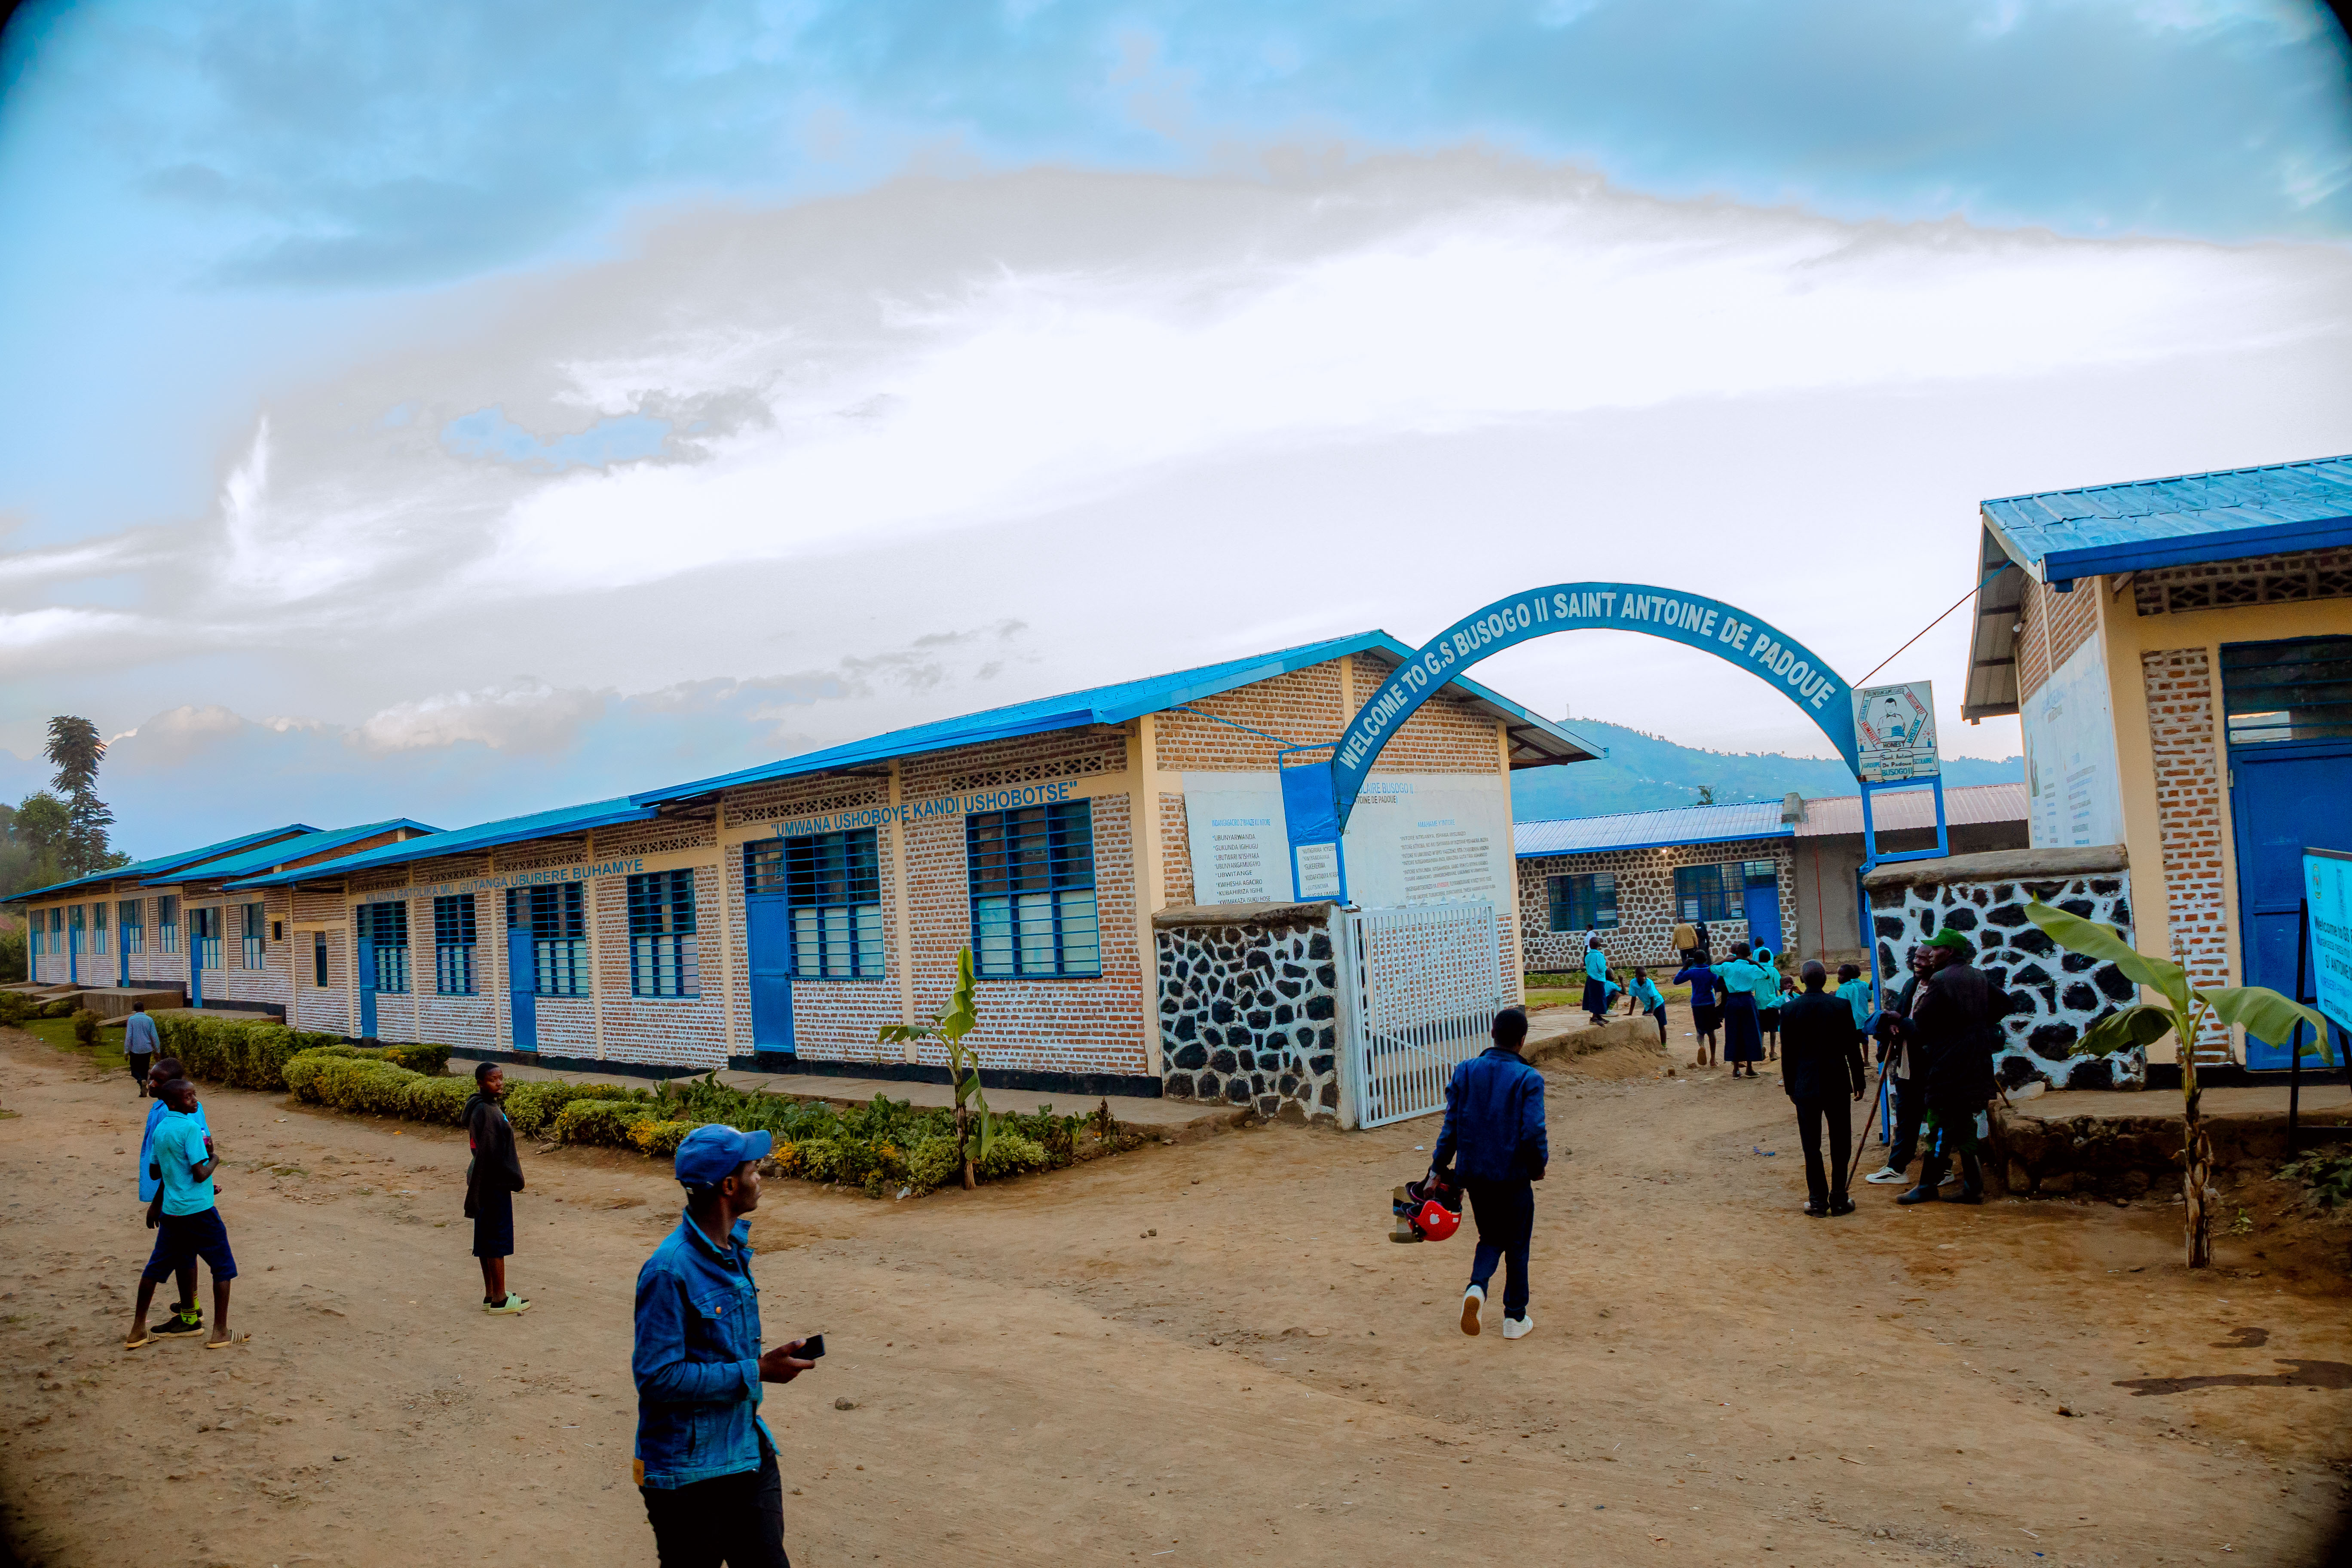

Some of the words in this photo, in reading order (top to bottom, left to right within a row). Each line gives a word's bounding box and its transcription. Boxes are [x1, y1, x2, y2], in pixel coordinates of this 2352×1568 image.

[1339, 683, 1408, 770] WELCOME
[1400, 665, 1428, 693] TO
[1424, 642, 1455, 675] G.S
[1452, 603, 1531, 657] BUSOGO
[1534, 597, 1548, 623] II
[1553, 592, 1617, 619] SAINT
[1620, 593, 1718, 637] ANTOINE
[1718, 616, 1753, 651] DE
[1749, 633, 1836, 709] PADOUE
[1881, 768, 1908, 776] BUSOGO
[1381, 782, 1409, 794] BUSOGO
[1371, 796, 1378, 804] DE
[834, 803, 909, 830] USHOBOYE
[913, 797, 961, 817] KANDI
[1216, 861, 1261, 870] UBUNYANGAMUGAYO
[440, 885, 454, 894] MU
[459, 877, 508, 893] GUTANGA
[511, 869, 568, 886] UBURERE
[573, 859, 643, 879] BUHAMYE
[2314, 915, 2337, 937] Welcome
